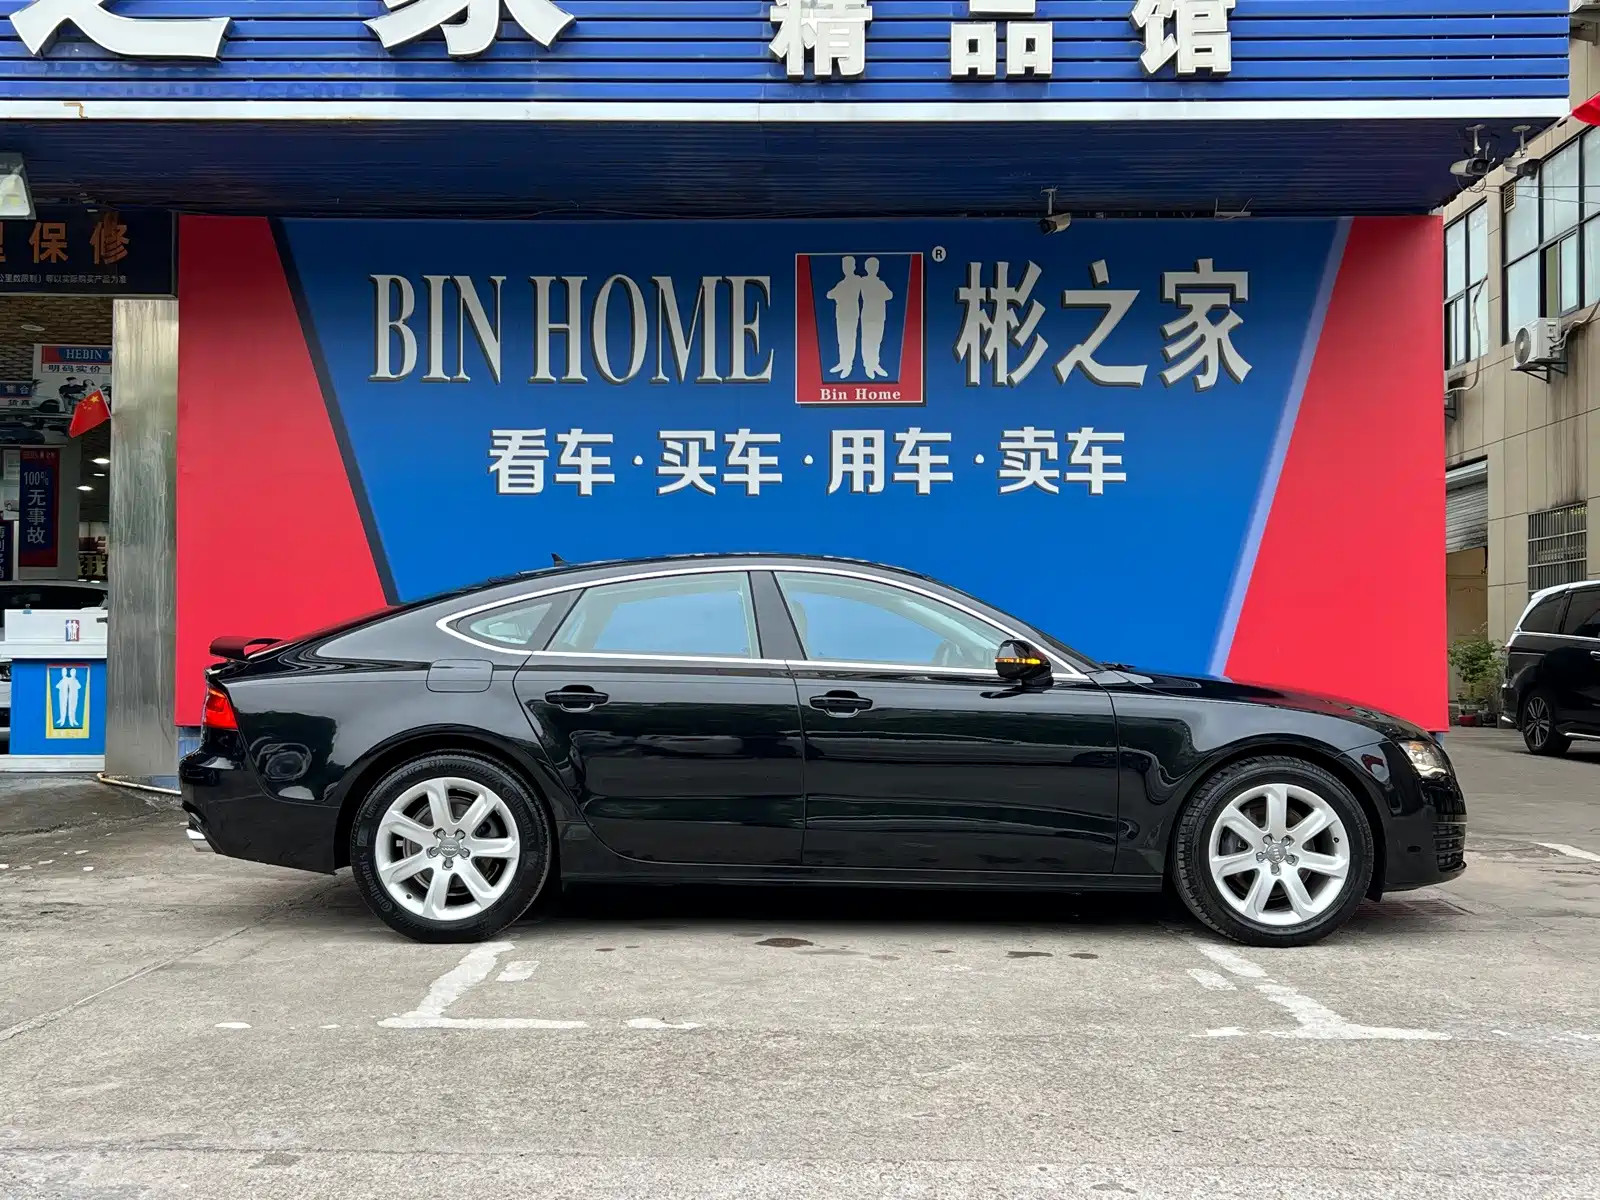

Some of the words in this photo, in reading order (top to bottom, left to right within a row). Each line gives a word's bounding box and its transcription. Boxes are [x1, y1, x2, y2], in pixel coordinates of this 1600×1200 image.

[0, 220, 130, 265] 保修
[368, 273, 507, 384] BIN
[528, 273, 774, 384] HOME
[954, 258, 1252, 391] 彬之家
[66, 349, 103, 360] HEBIN
[820, 388, 848, 400] Bin
[855, 388, 901, 400] Home
[24, 471, 49, 486] 100%
[26, 489, 47, 544] 无事故
[502, 786, 535, 837] Continental
[357, 860, 392, 912] Continental
